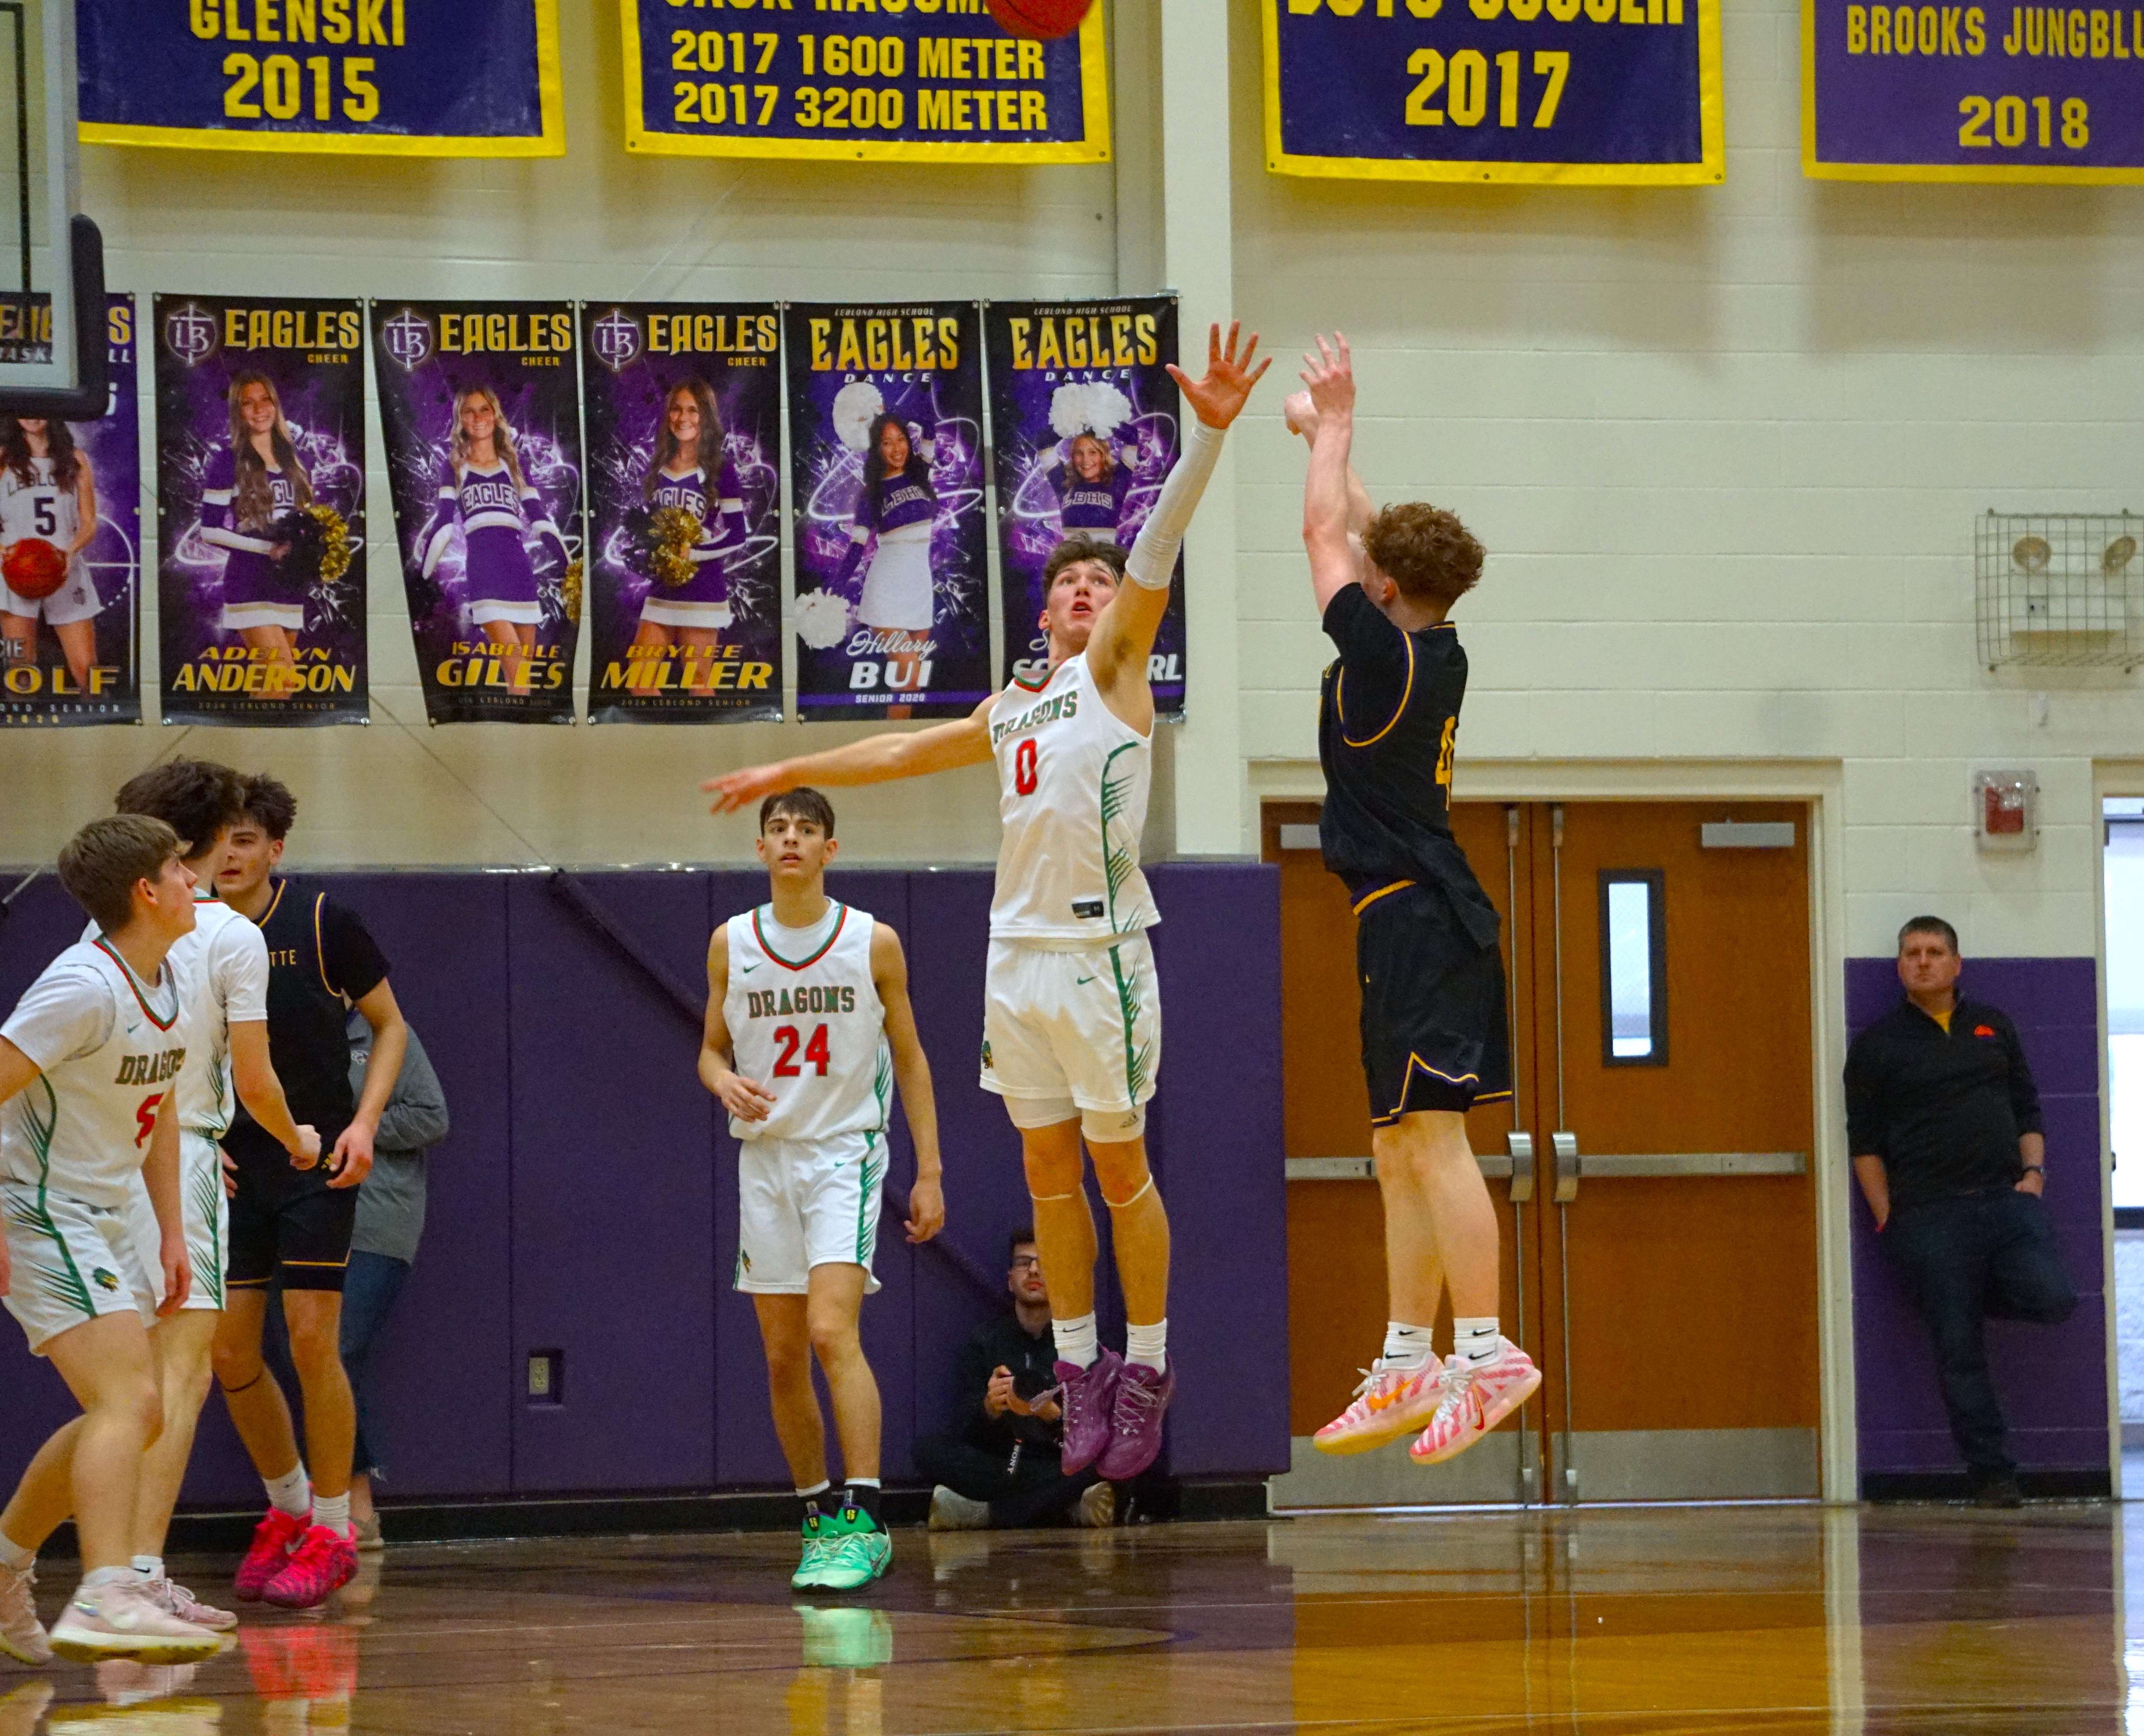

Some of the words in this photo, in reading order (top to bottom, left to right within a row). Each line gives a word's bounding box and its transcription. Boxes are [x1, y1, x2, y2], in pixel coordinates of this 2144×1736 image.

[189, 0, 406, 46] GLENSKI
[1847, 5, 1986, 56] BROOKS
[671, 30, 779, 75] 2017
[797, 34, 905, 77] 1600
[917, 38, 1044, 79] METER
[222, 53, 381, 122] 2015
[673, 82, 779, 126] 2017
[795, 86, 905, 129] 3200
[917, 89, 1047, 131] METER
[1405, 48, 1570, 128] 2017
[1958, 95, 2089, 148] 2018
[1075, 306, 1097, 315] HIGH
[1100, 305, 1132, 314] SCHOOL
[224, 309, 359, 351] EAGLES
[439, 314, 571, 355] EAGLES
[648, 315, 776, 355] EAGLES
[809, 317, 959, 371] EAGLES
[1009, 314, 1157, 369] EAGLES
[307, 354, 349, 364] CHEER
[521, 356, 560, 366] CHEER
[727, 357, 767, 367] CHEER
[844, 373, 931, 383] DANCE
[1045, 369, 1130, 381] DANCE
[33, 497, 56, 536] 5
[452, 641, 560, 658] ISABELLE
[626, 645, 743, 658] BRYLEE
[846, 631, 937, 661] Hillary
[172, 663, 356, 692] ANDERSON
[436, 658, 566, 690] GILES
[600, 662, 773, 689] MILLER
[849, 660, 933, 689] BUI
[855, 694, 893, 704] SENIOR
[993, 690, 1078, 744] DRAGONS
[1015, 737, 1038, 796] 0
[747, 986, 855, 1019] DRAGONS
[773, 1023, 830, 1078] 24
